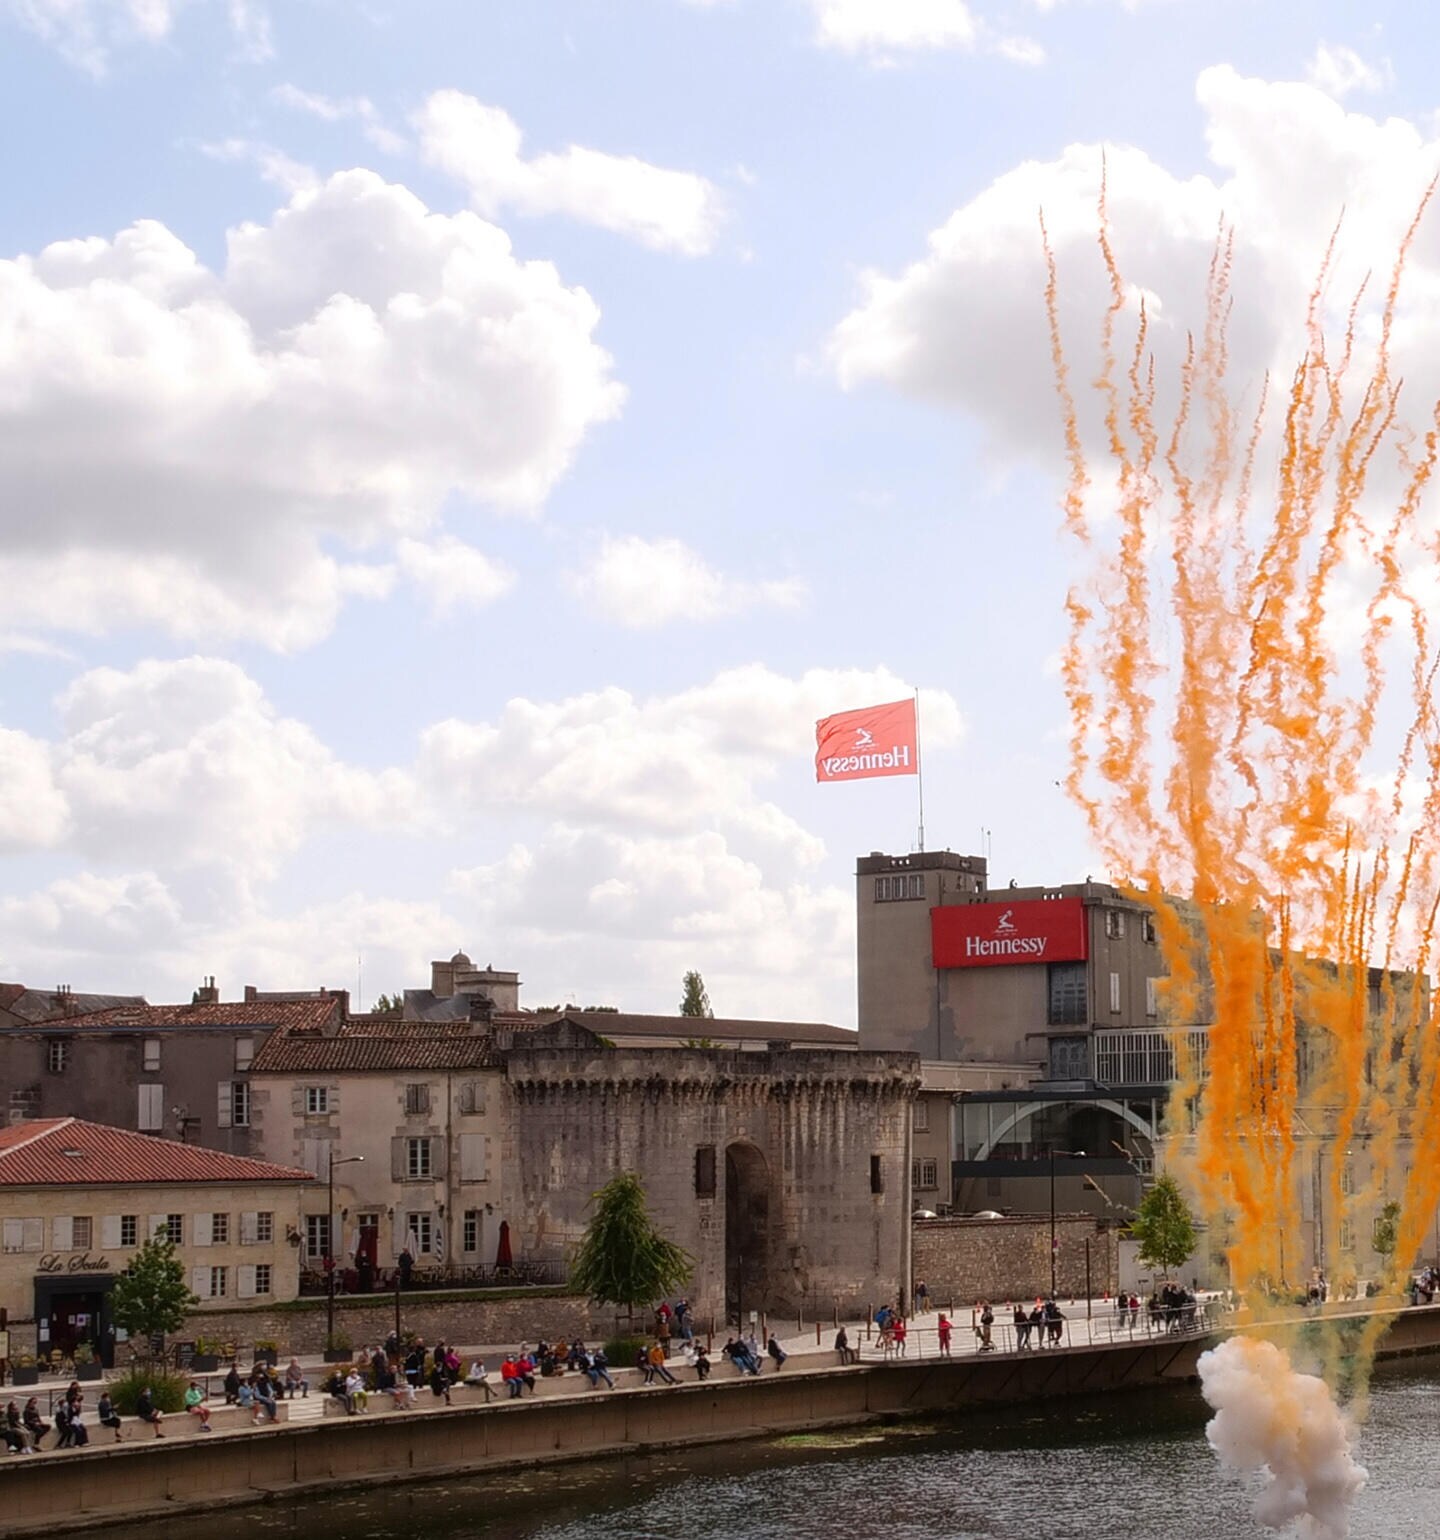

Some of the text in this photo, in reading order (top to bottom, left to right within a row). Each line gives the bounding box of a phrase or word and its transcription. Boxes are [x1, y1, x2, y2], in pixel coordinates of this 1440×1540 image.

[966, 936, 1047, 956] Hennessy
[37, 1252, 109, 1274] La Scala
